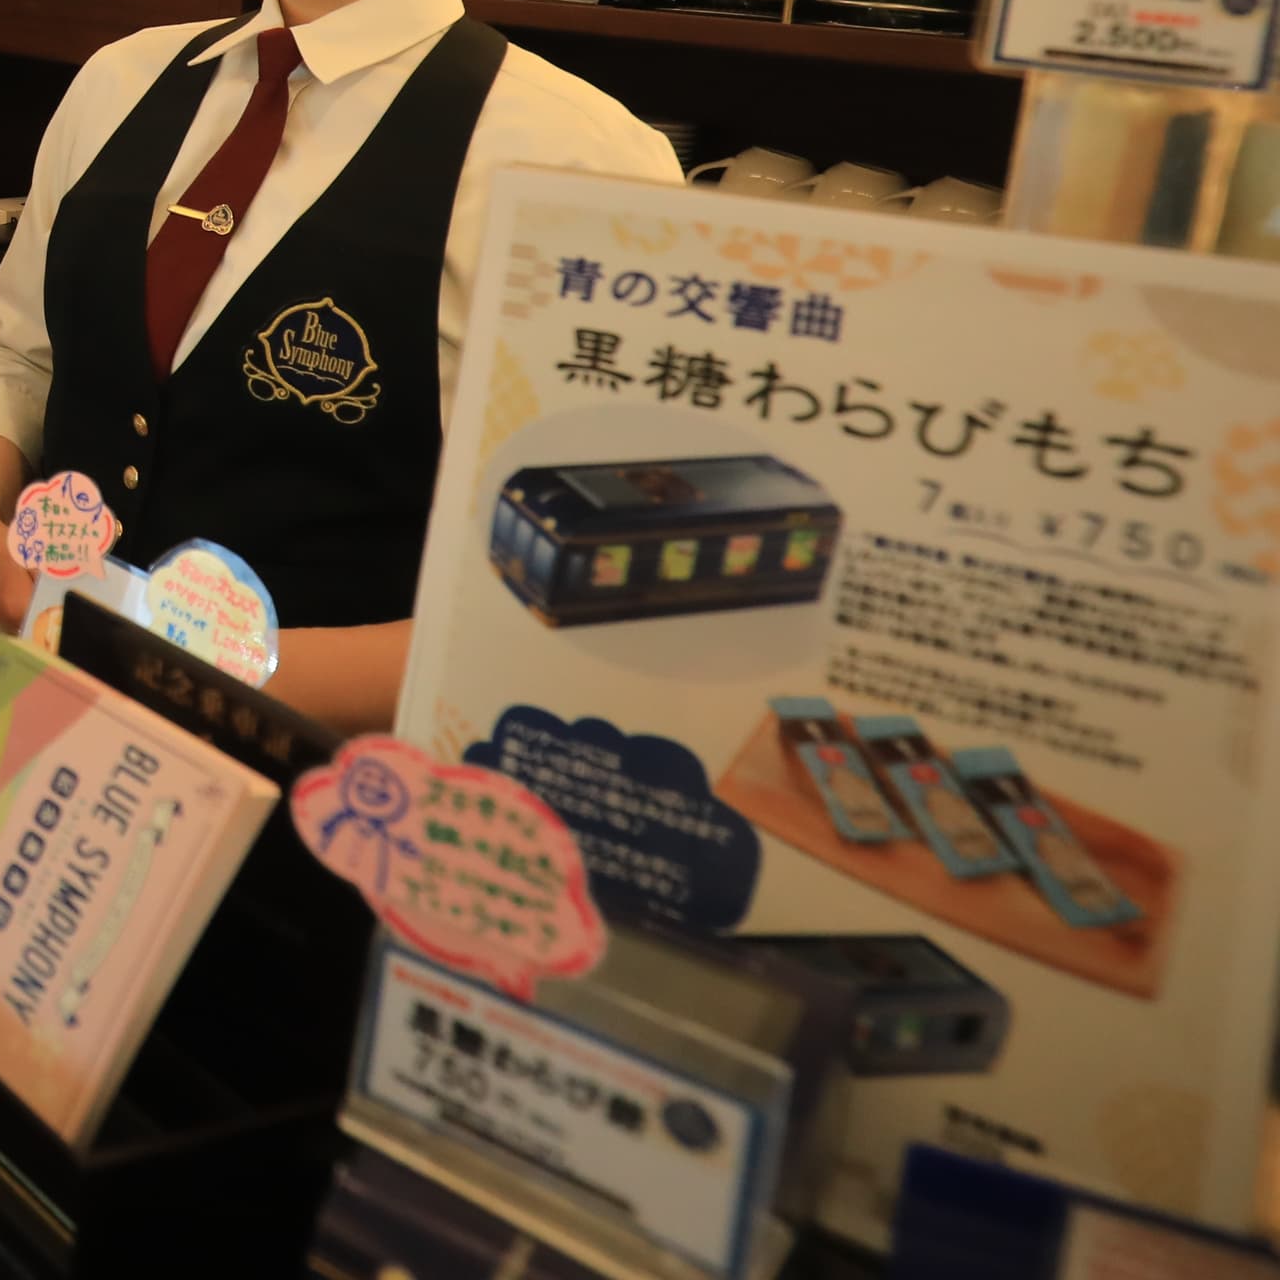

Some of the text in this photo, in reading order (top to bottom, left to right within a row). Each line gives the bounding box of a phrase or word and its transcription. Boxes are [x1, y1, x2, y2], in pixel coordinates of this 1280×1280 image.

[302, 311, 338, 351] Blue
[555, 257, 845, 344] 青の交響曲
[279, 328, 355, 381] Symphony
[555, 326, 1198, 499] 黒糖わらびもち
[93, 743, 160, 837] BLUE
[3, 836, 110, 1028] SYMPHONY
